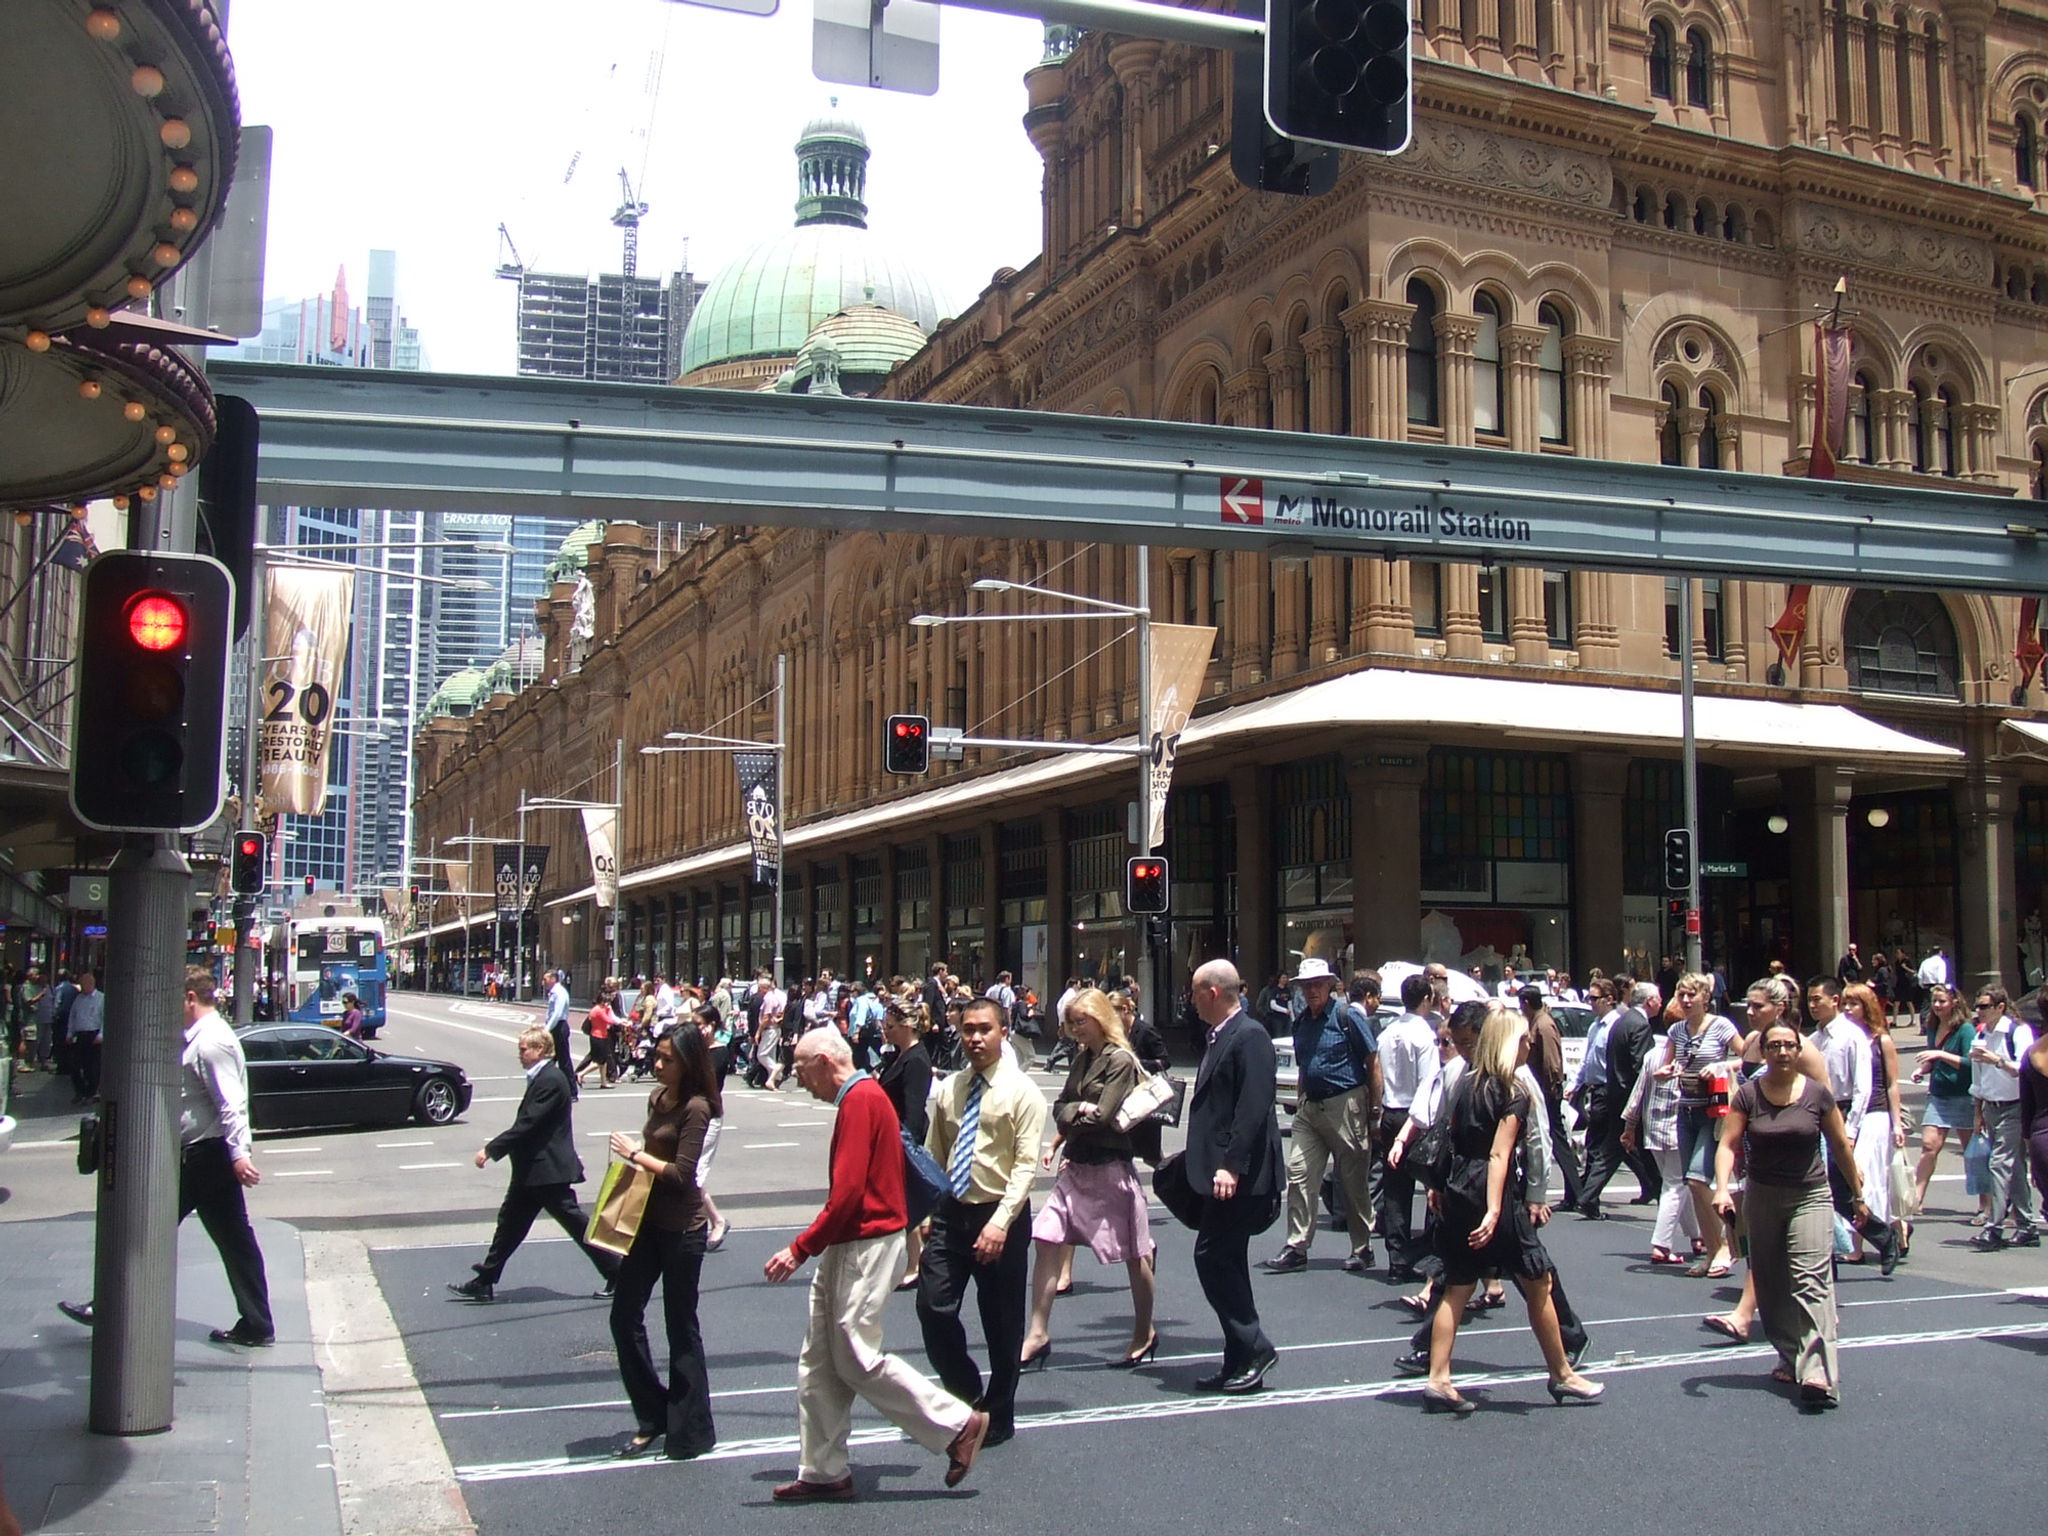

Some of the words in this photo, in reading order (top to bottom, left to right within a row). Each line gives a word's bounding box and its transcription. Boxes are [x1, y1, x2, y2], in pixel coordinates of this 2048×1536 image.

[443, 512, 479, 524] ERNST
[480, 513, 490, 525] &
[1274, 517, 1302, 526] metro
[1311, 497, 1430, 534] Monorail
[1439, 506, 1531, 541] Station
[264, 682, 330, 727] 20
[264, 724, 308, 736] YEARS
[310, 729, 325, 740] OF
[263, 737, 324, 752] RESTORED
[264, 749, 321, 766] BEAUTY
[331, 937, 344, 948] 40
